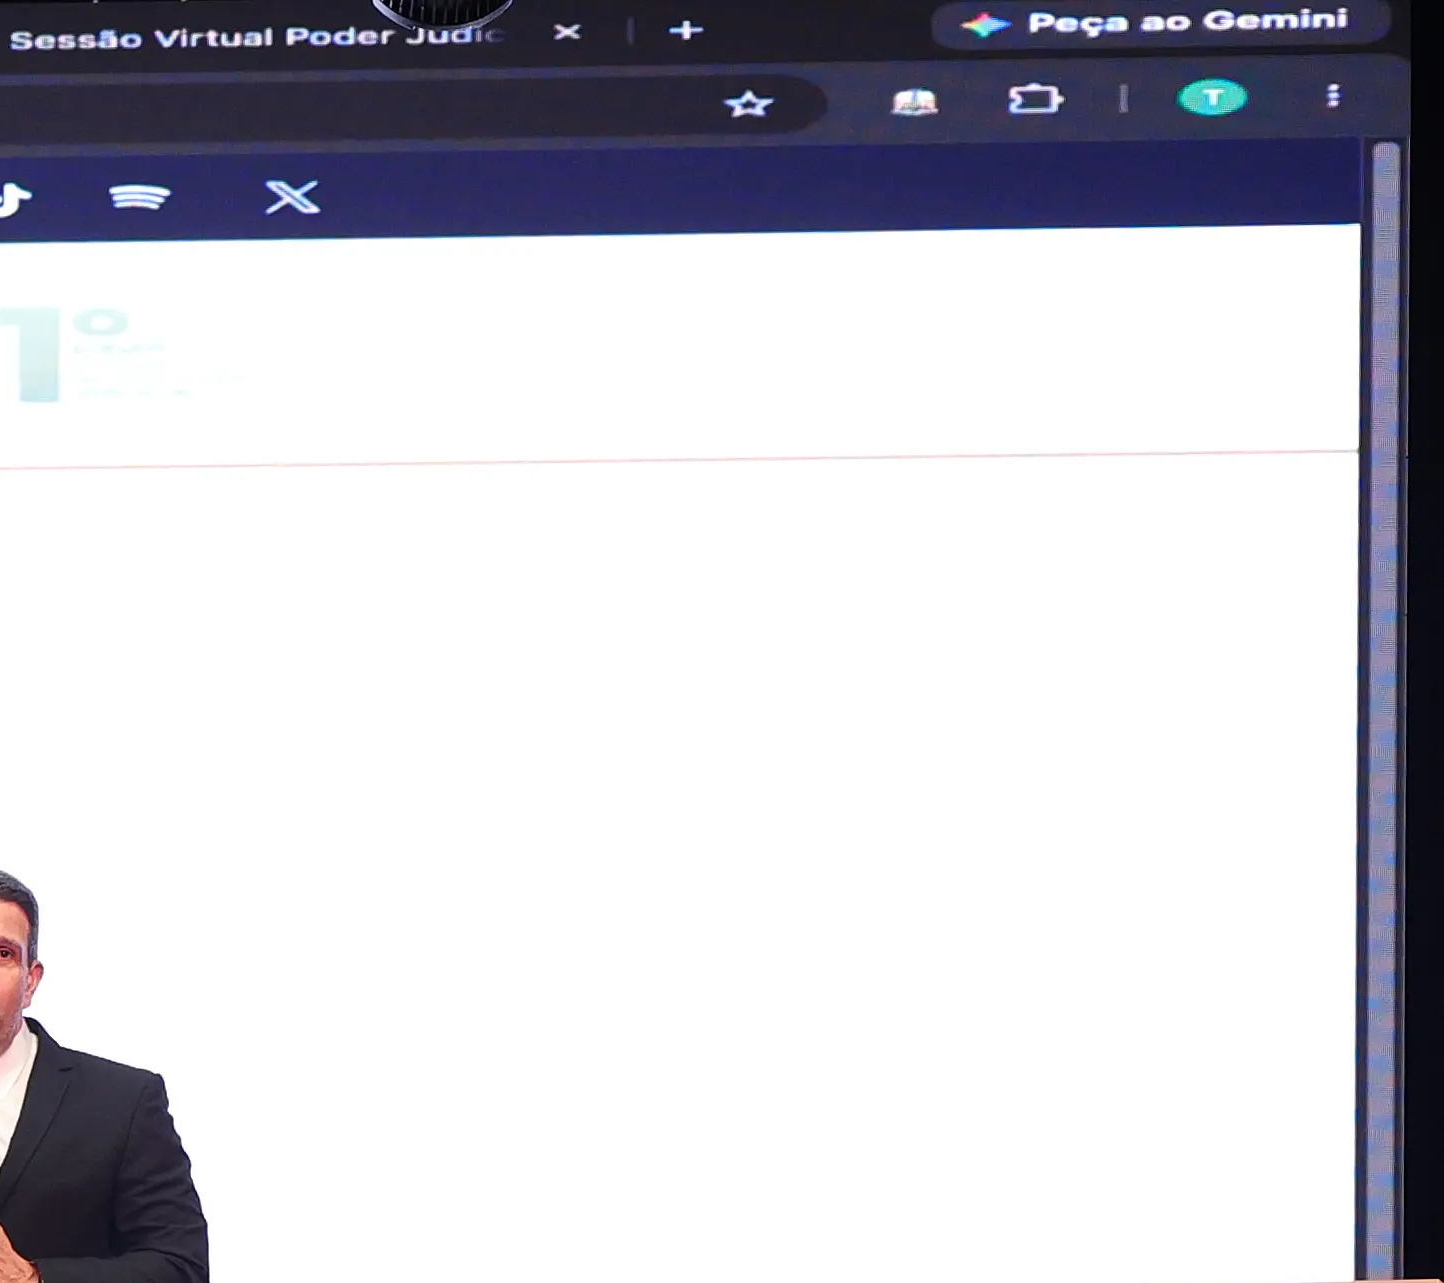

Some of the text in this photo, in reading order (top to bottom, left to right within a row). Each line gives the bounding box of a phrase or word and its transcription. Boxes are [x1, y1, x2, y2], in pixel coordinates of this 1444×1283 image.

[1028, 8, 1348, 38] Peça ao Gemini
[10, 30, 143, 50] Sessão
[154, 28, 272, 48] Virtual
[286, 26, 394, 46] Poder
[1203, 89, 1224, 110] T
